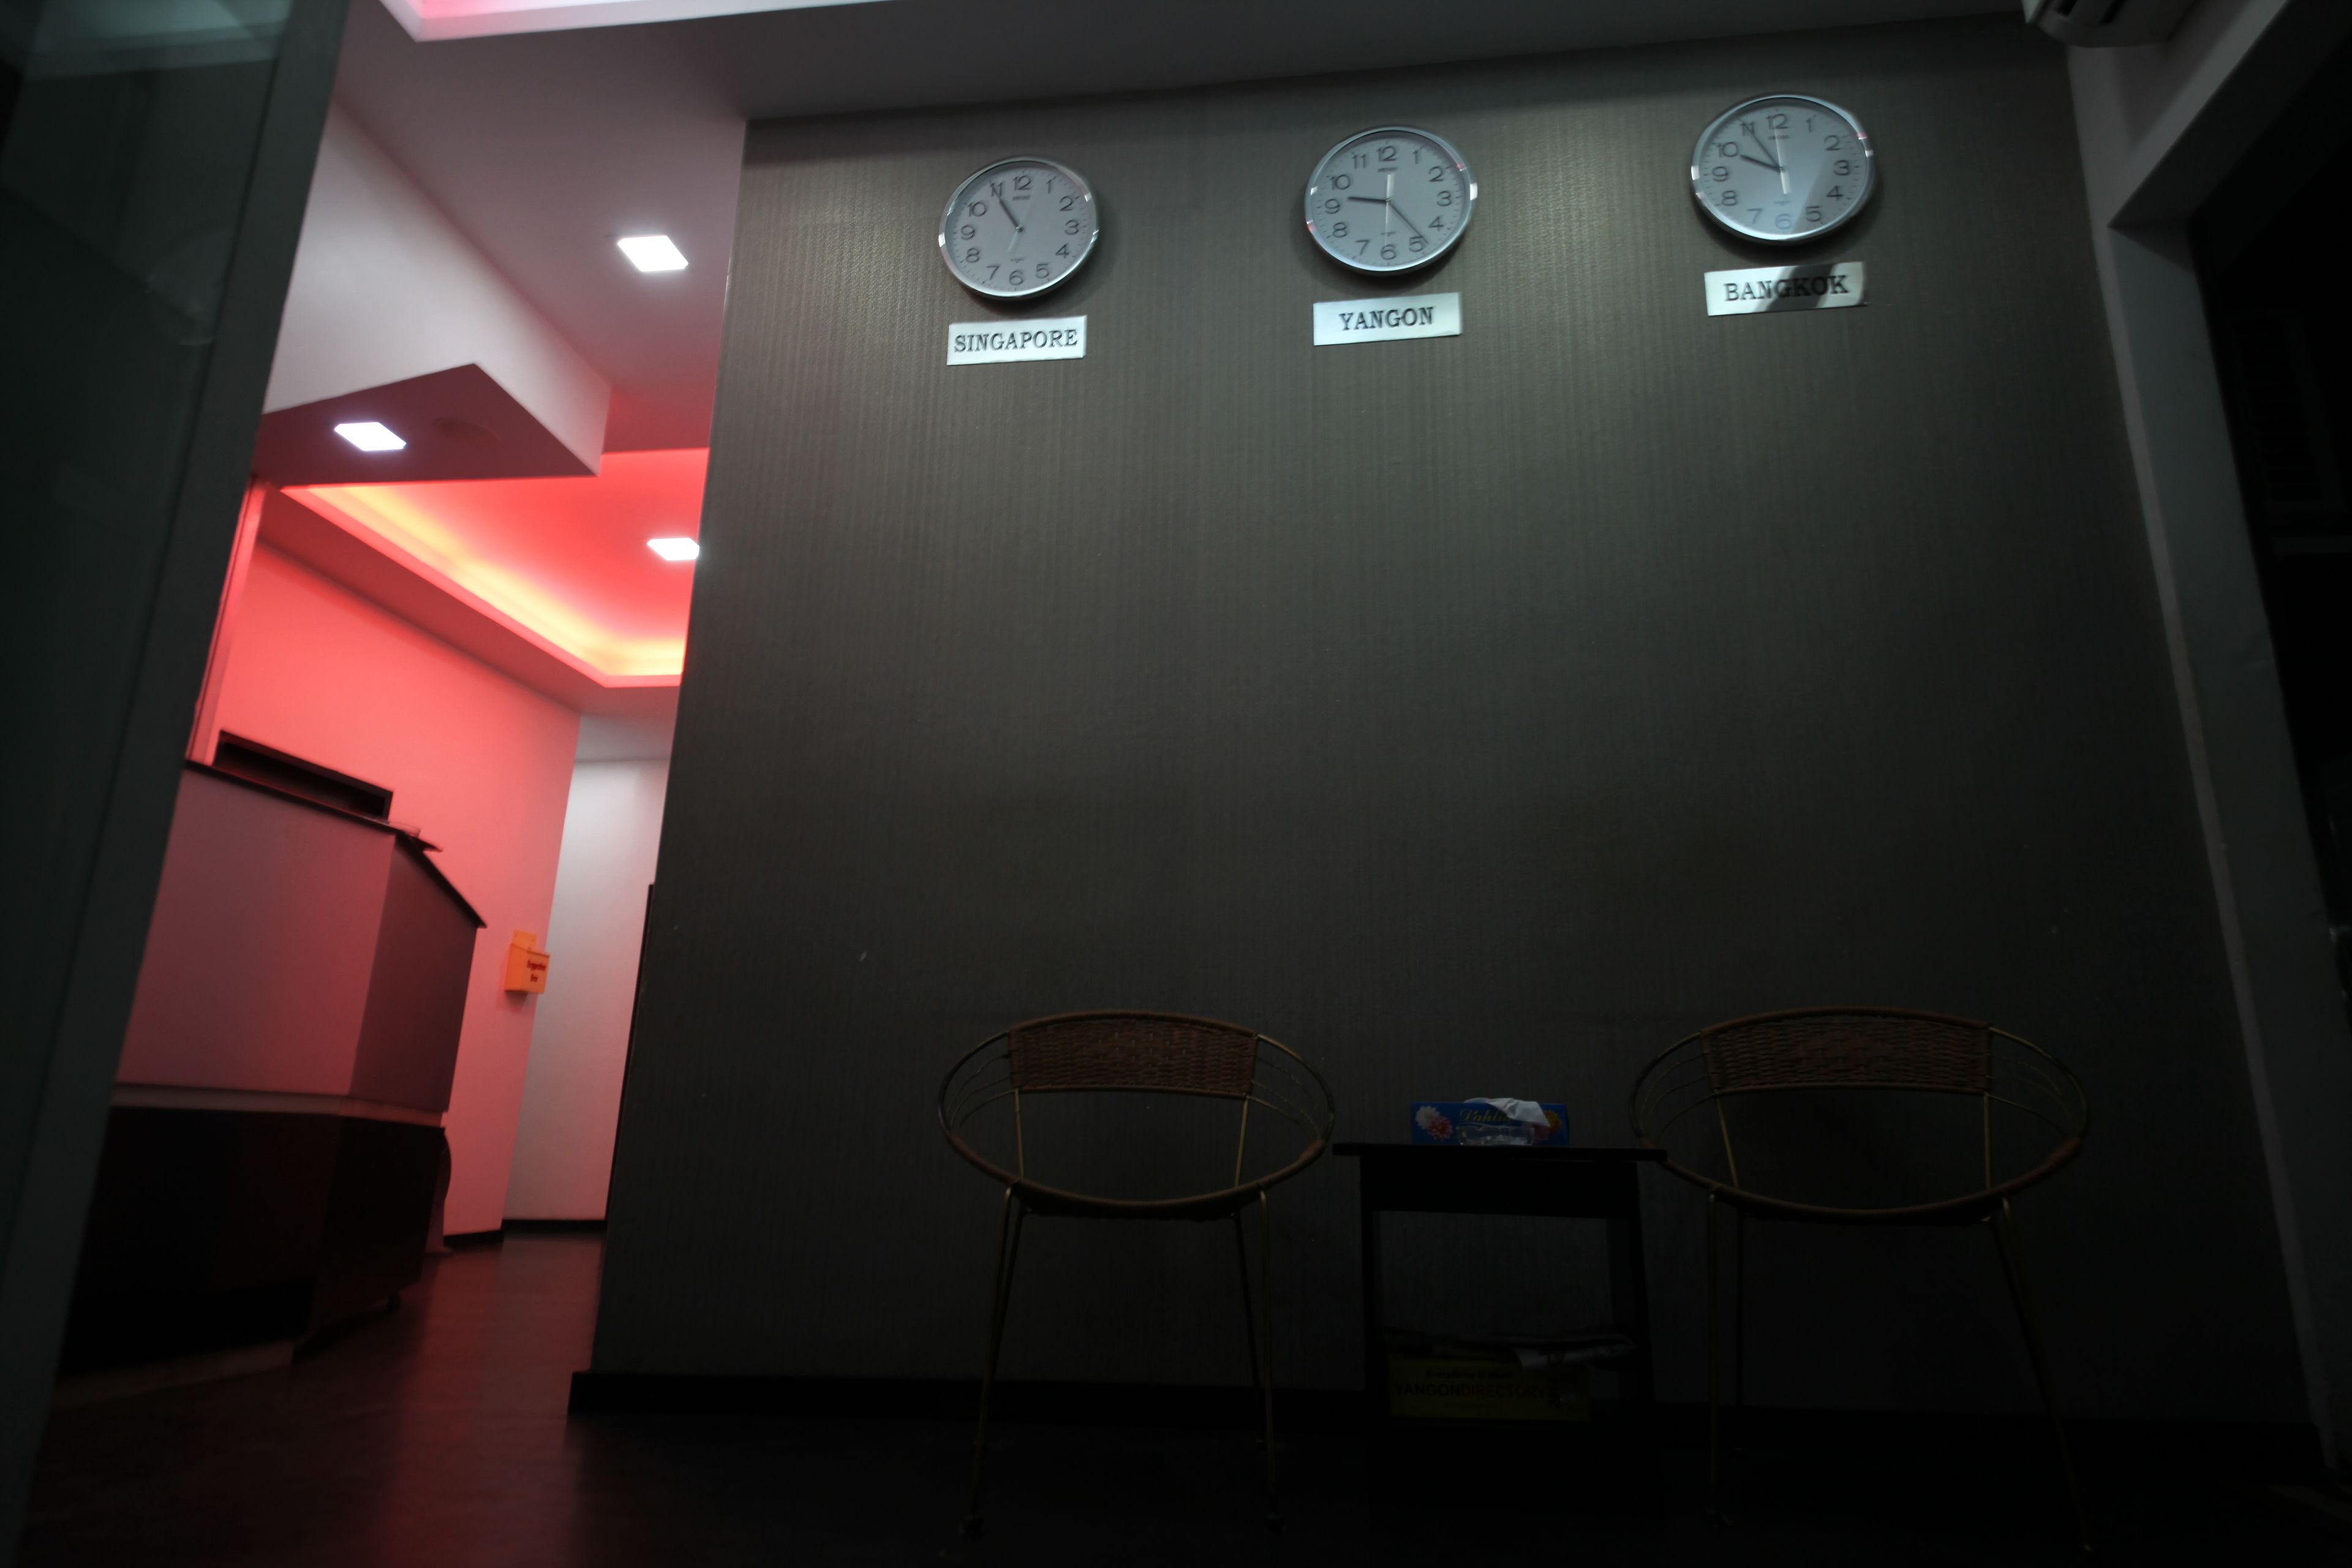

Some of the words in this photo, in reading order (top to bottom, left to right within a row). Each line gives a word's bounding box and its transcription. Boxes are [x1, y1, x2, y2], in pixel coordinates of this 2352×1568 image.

[1741, 122, 1755, 136] 11
[1766, 114, 1789, 130] 12
[1806, 117, 1813, 133] 1
[1717, 142, 1739, 158] 10
[1823, 135, 1841, 151] 2
[1352, 154, 1366, 168] 11
[1377, 146, 1396, 162] 12
[1412, 149, 1419, 164] 1
[1428, 166, 1443, 183] 2
[1712, 166, 1728, 182] 9
[1833, 160, 1850, 176] 3
[990, 182, 1003, 197] 11
[1013, 175, 1031, 191] 12
[1046, 179, 1054, 194] 1
[1330, 175, 1351, 190] 10
[1437, 190, 1452, 207] 3
[1721, 190, 1738, 206] 8
[1826, 185, 1843, 201] 4
[968, 202, 987, 217] 10
[1060, 196, 1074, 212] 2
[1324, 198, 1341, 214] 9
[1747, 208, 1763, 224] 7
[1776, 214, 1793, 230] 6
[1806, 206, 1822, 222] 5
[1065, 220, 1079, 235] 3
[1332, 222, 1348, 238] 8
[1428, 216, 1444, 232] 4
[960, 225, 976, 240] 9
[1055, 244, 1069, 258] 4
[1355, 240, 1371, 255] 7
[1381, 244, 1396, 260] 6
[1409, 236, 1425, 253] 5
[965, 248, 980, 263] 8
[986, 265, 1000, 280] 7
[1009, 270, 1023, 285] 6
[1035, 263, 1049, 279] 5
[1724, 275, 1849, 301] BANGKOK
[1339, 307, 1434, 331] YANGON
[954, 329, 1078, 353] SINGAPORE
